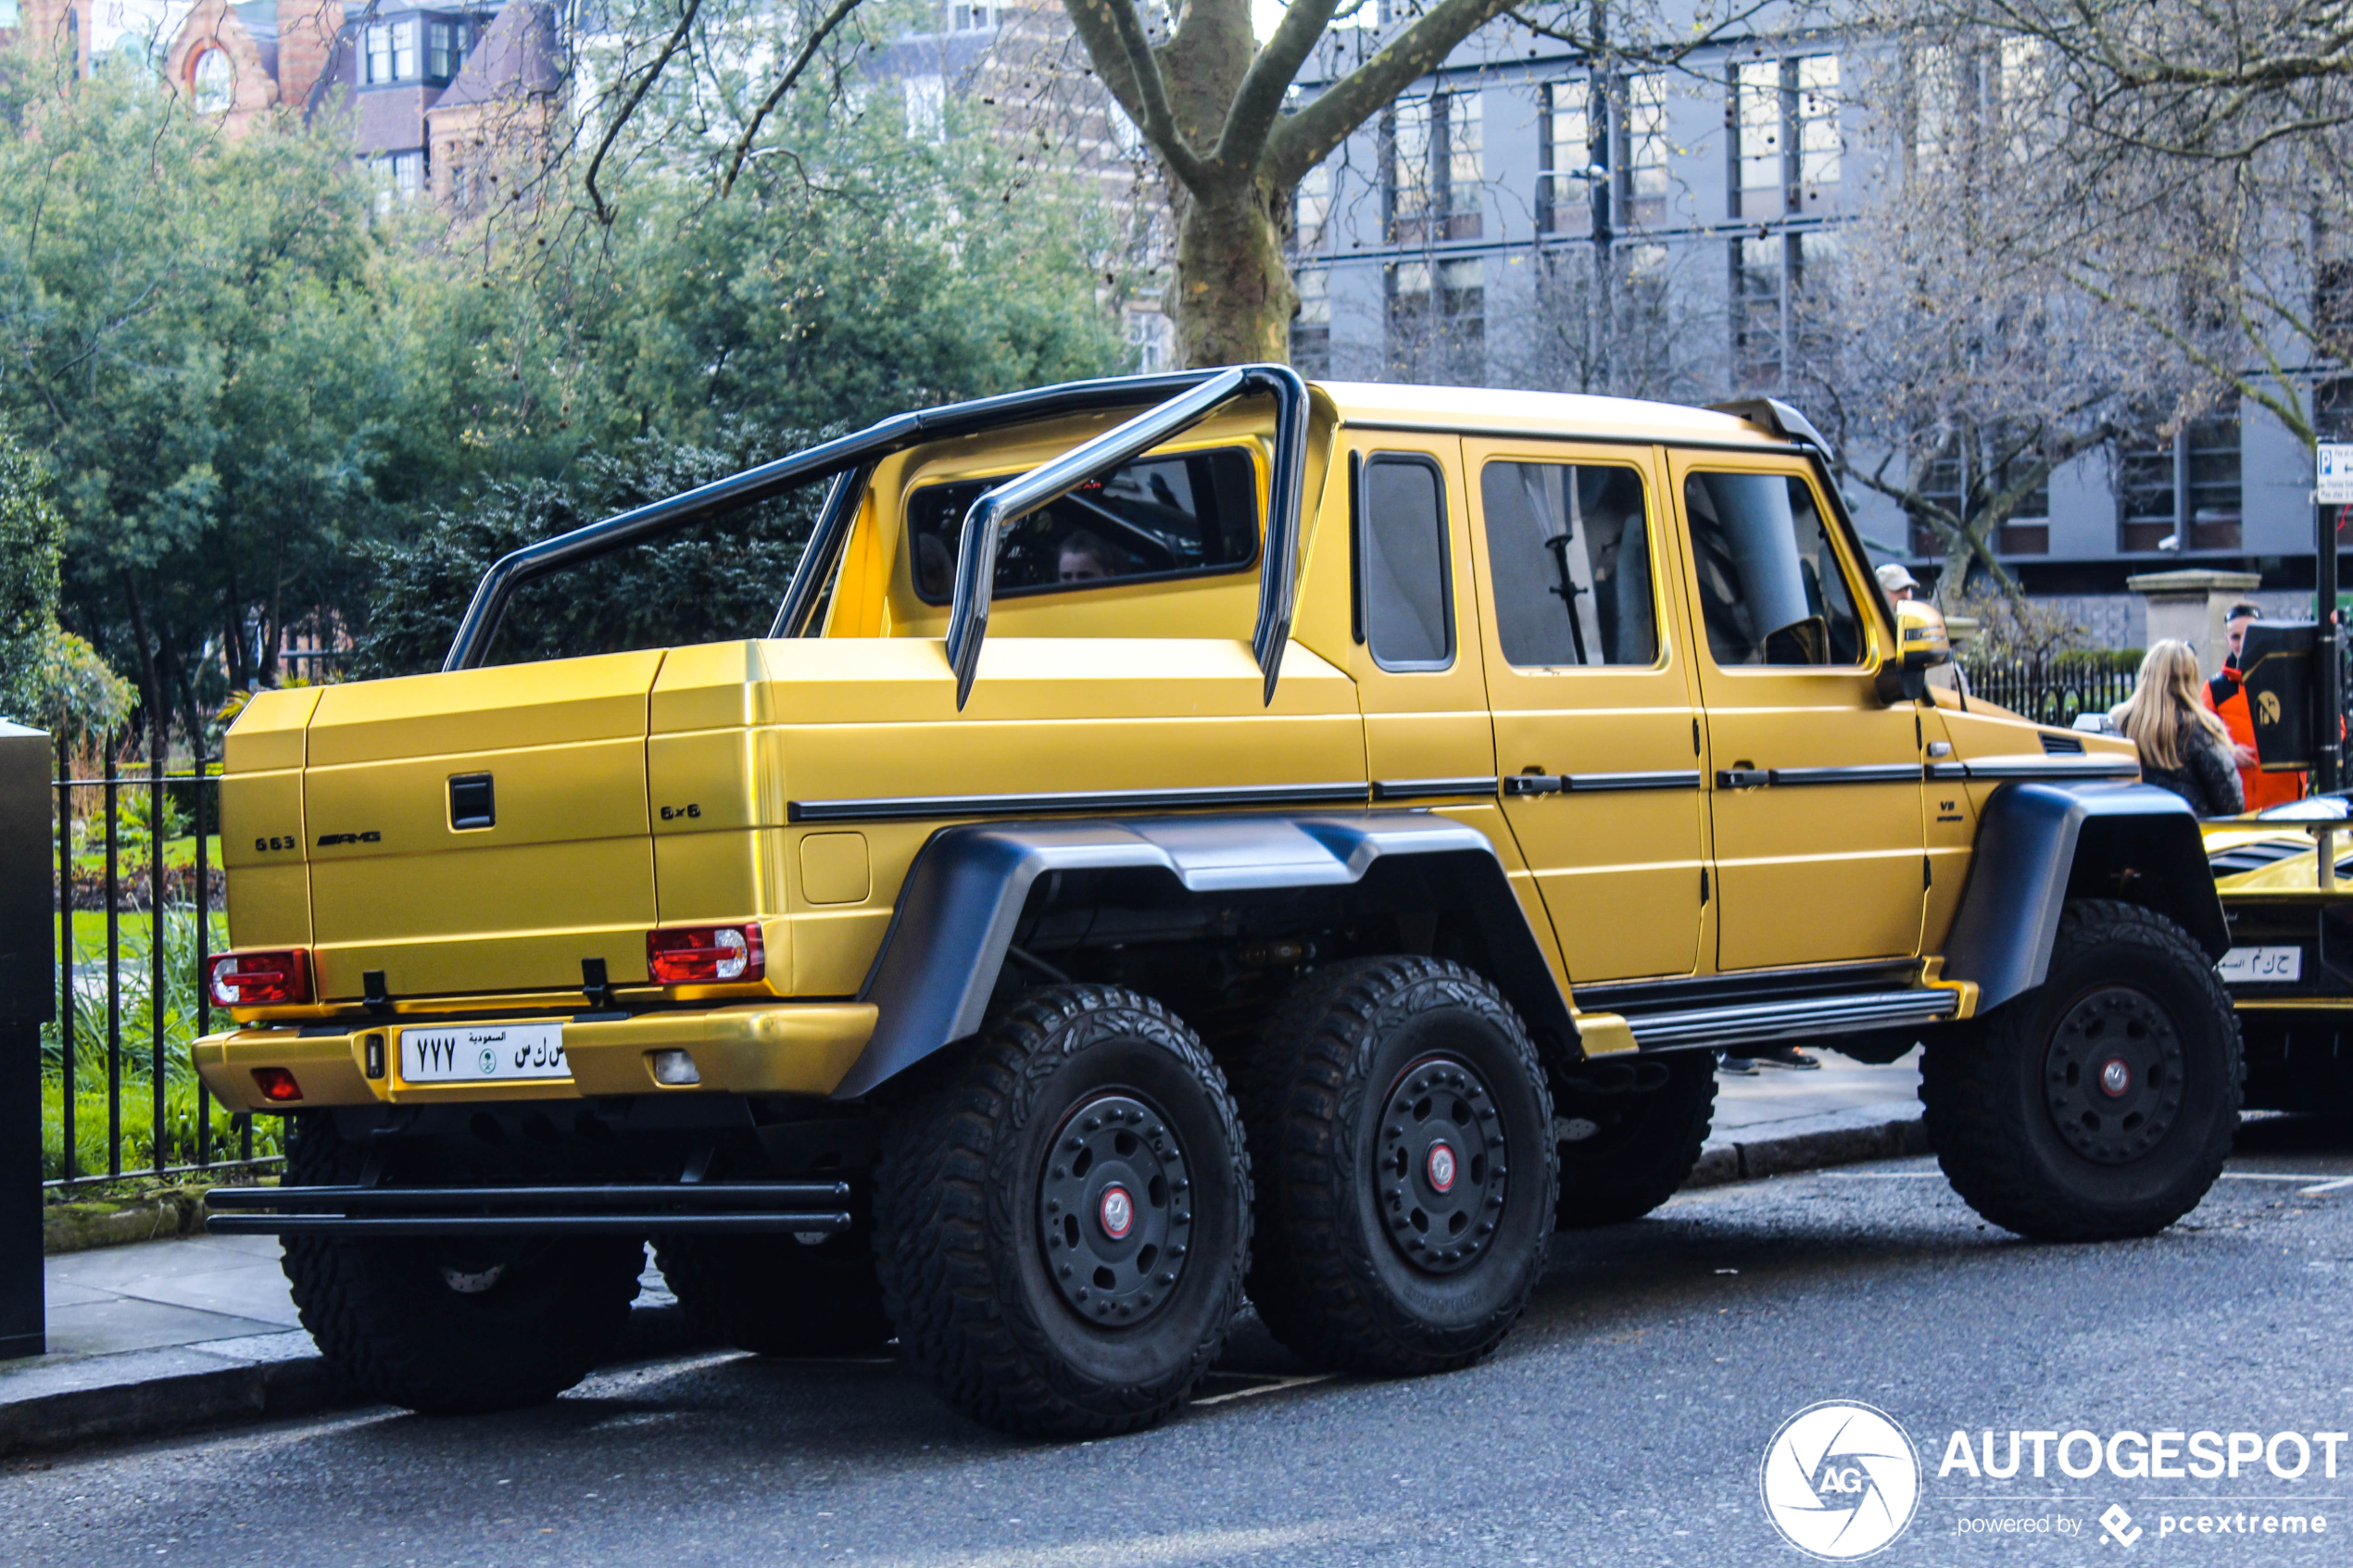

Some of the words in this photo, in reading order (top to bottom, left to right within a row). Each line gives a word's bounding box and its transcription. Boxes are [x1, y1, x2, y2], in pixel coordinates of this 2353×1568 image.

[2322, 451, 2331, 473] P
[336, 831, 382, 845] AMG
[469, 1031, 507, 1045] السعودية
